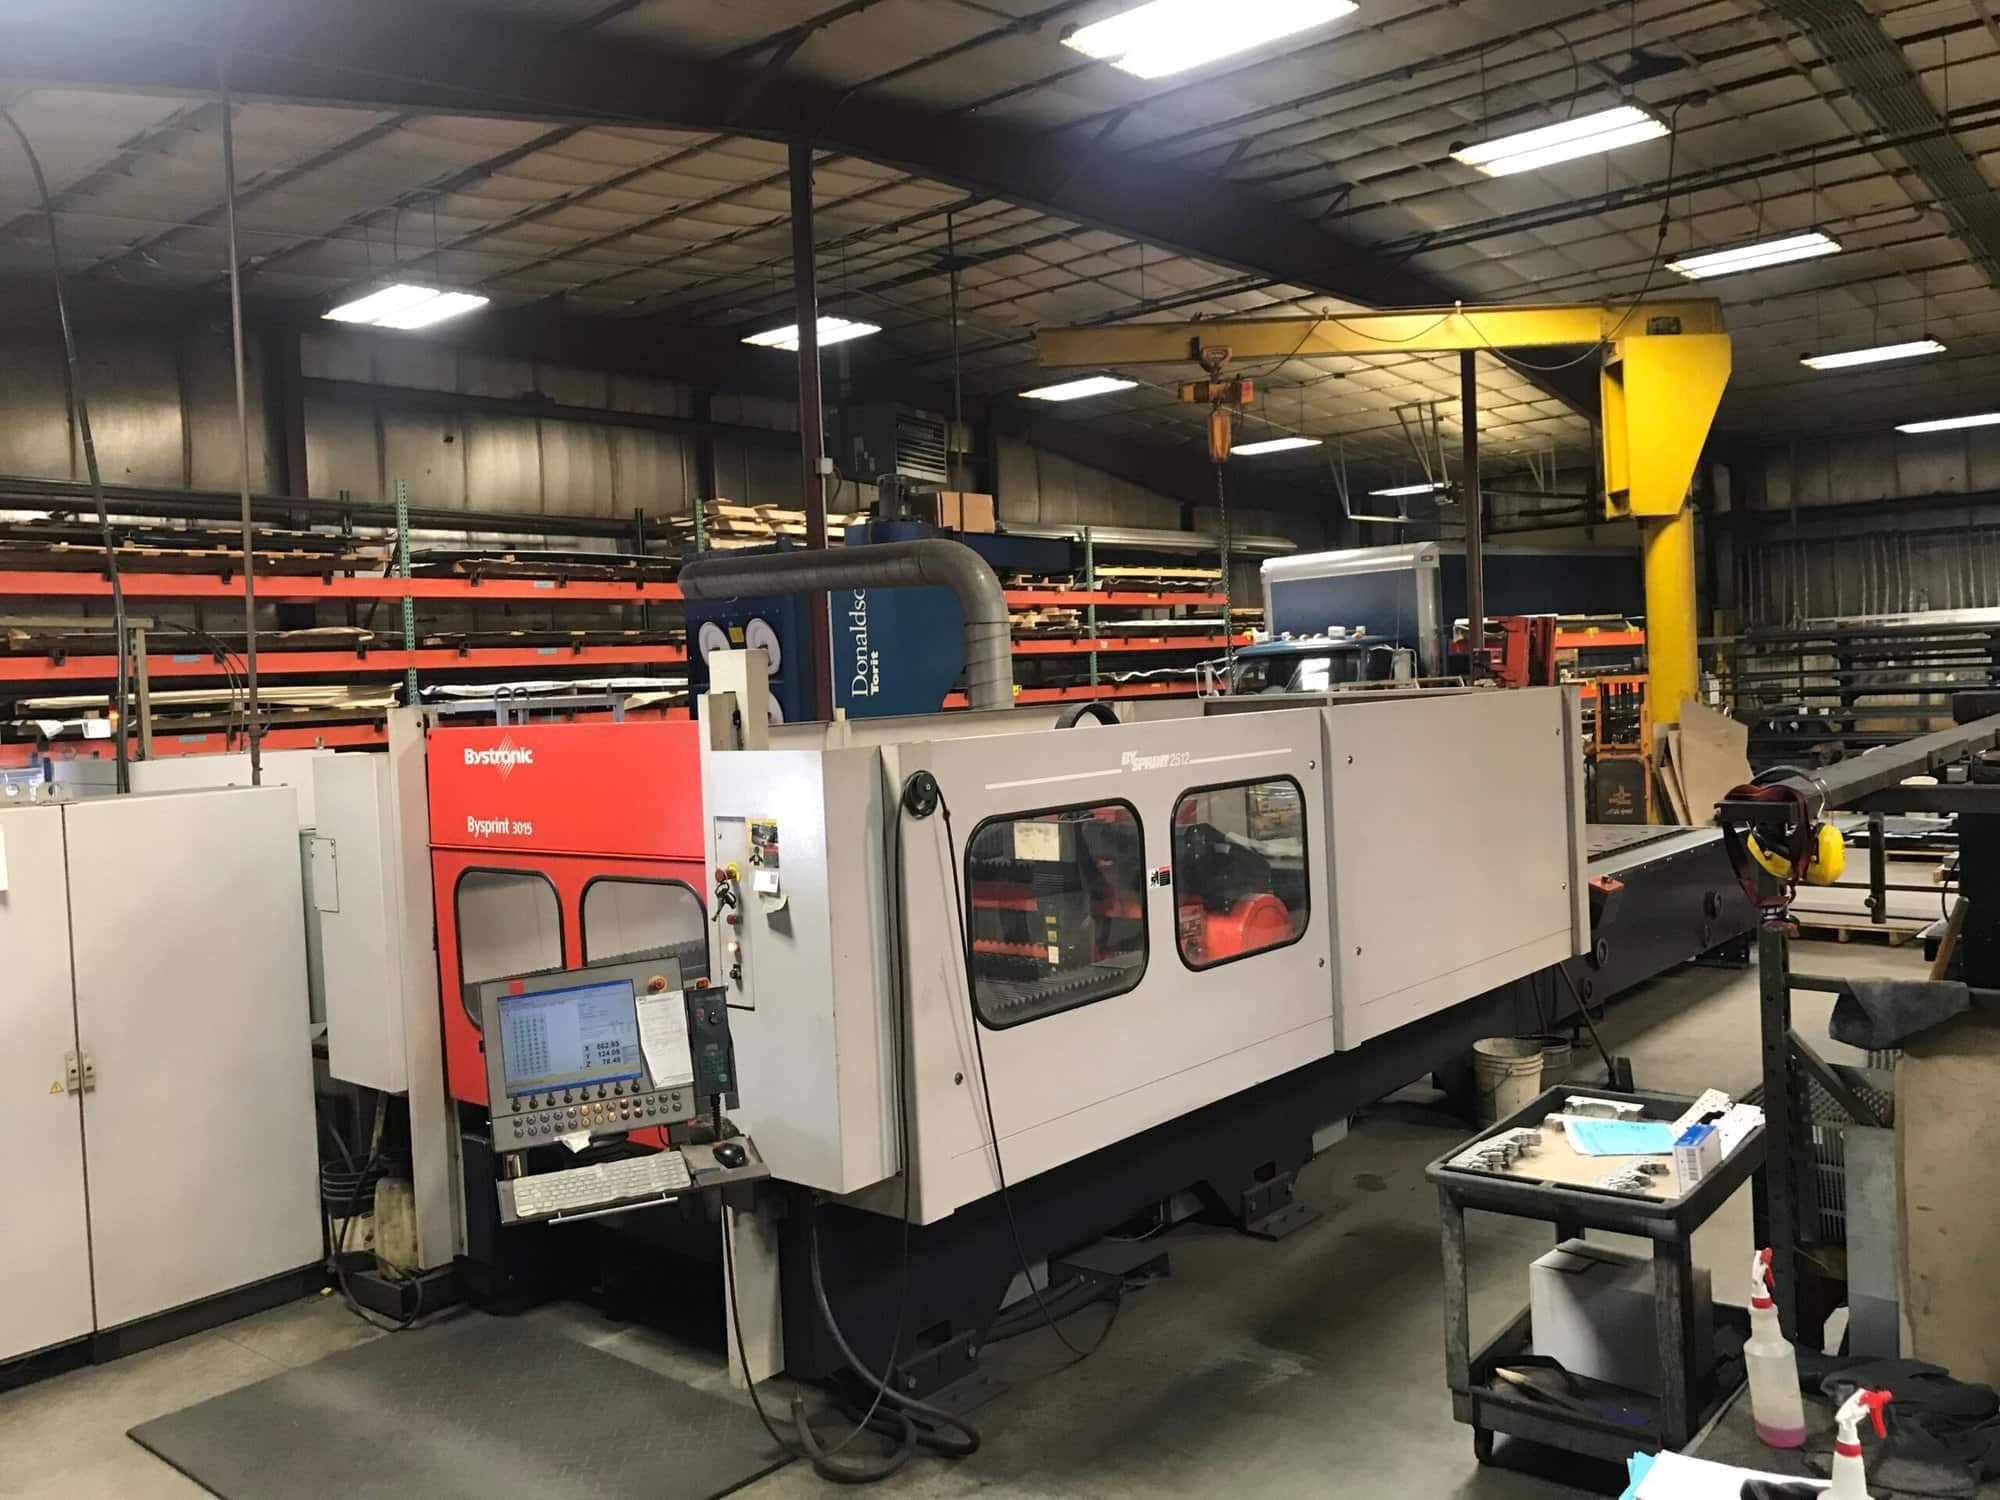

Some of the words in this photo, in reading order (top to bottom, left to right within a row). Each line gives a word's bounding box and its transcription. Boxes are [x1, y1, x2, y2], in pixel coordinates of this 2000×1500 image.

[870, 650, 880, 696] Torit
[464, 747, 534, 765] Bystronic
[467, 816, 510, 838] Bysprint
[512, 821, 533, 836] 3015
